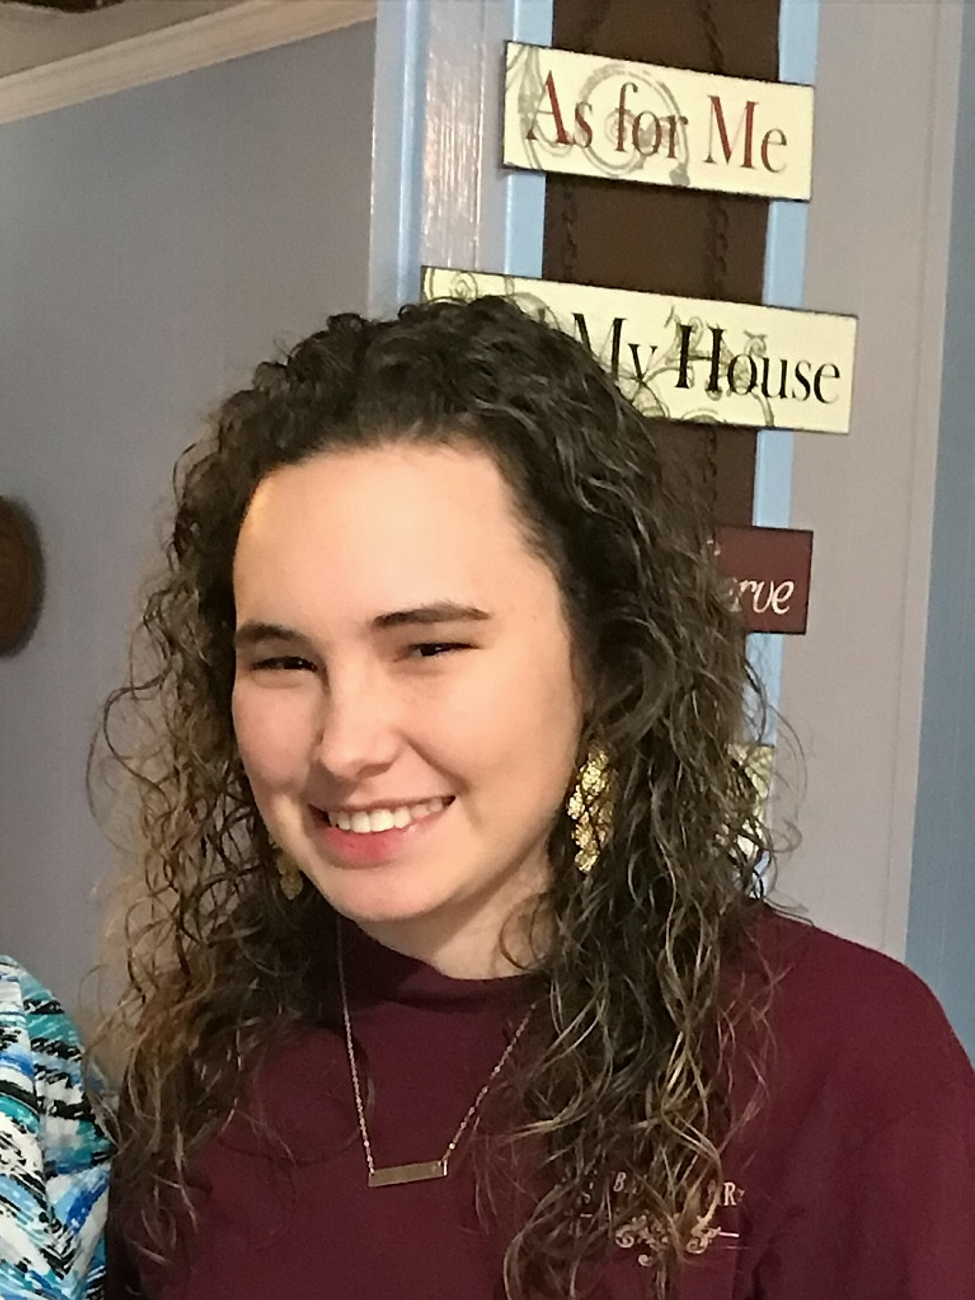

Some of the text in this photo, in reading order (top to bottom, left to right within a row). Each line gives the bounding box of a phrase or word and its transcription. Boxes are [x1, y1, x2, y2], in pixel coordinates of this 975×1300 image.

[525, 70, 788, 174] As for Me
[571, 311, 841, 405] My House
[726, 577, 795, 615] rve
